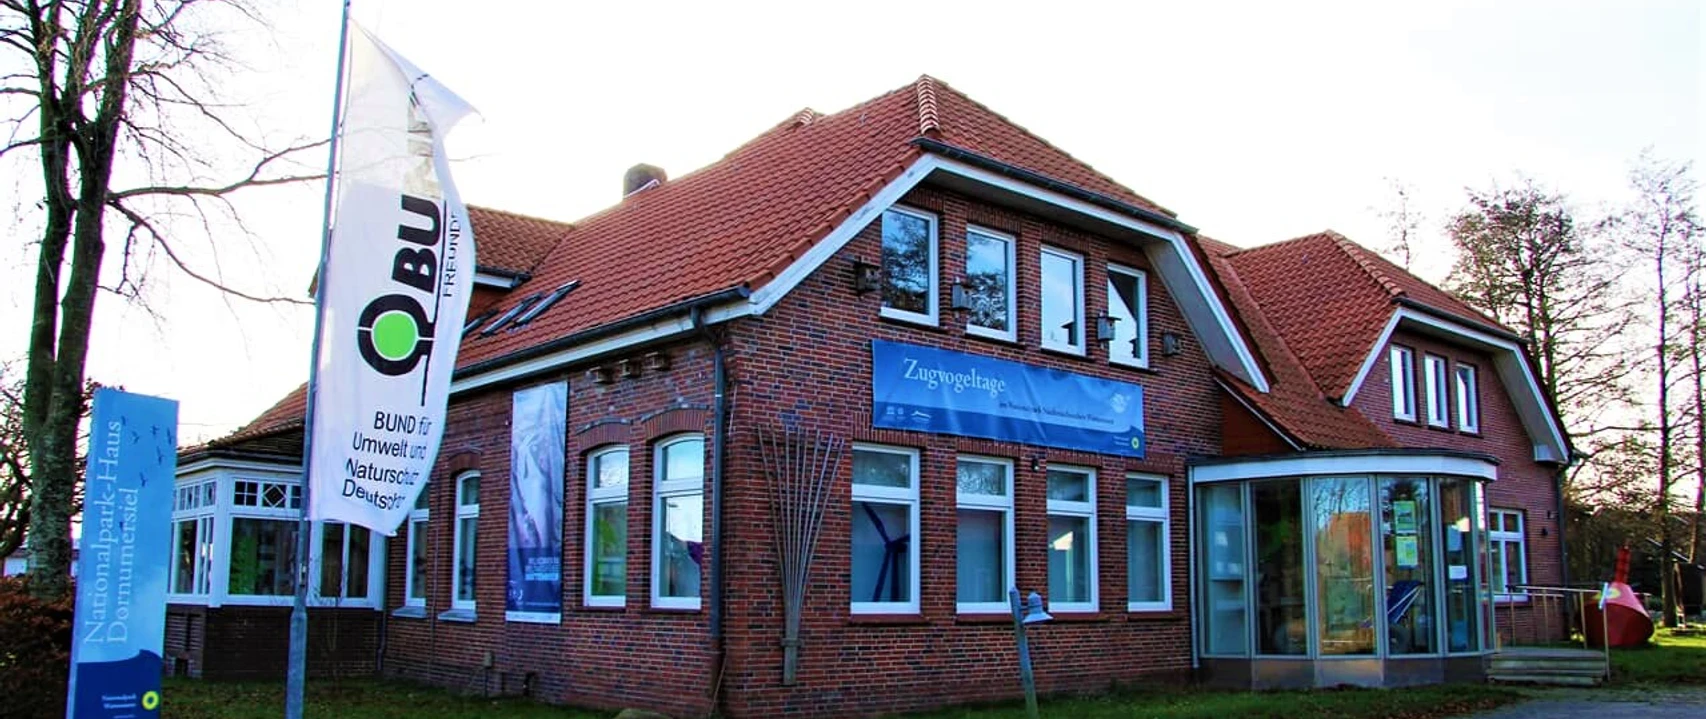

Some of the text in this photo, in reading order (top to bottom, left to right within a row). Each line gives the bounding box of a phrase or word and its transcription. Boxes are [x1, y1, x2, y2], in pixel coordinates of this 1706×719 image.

[903, 358, 1007, 400] Zugvogeltage
[373, 411, 416, 434] BUND
[352, 431, 408, 458] Umwelt
[83, 420, 121, 645] Nationalpark-Haus
[106, 487, 139, 643] Dornumersiel
